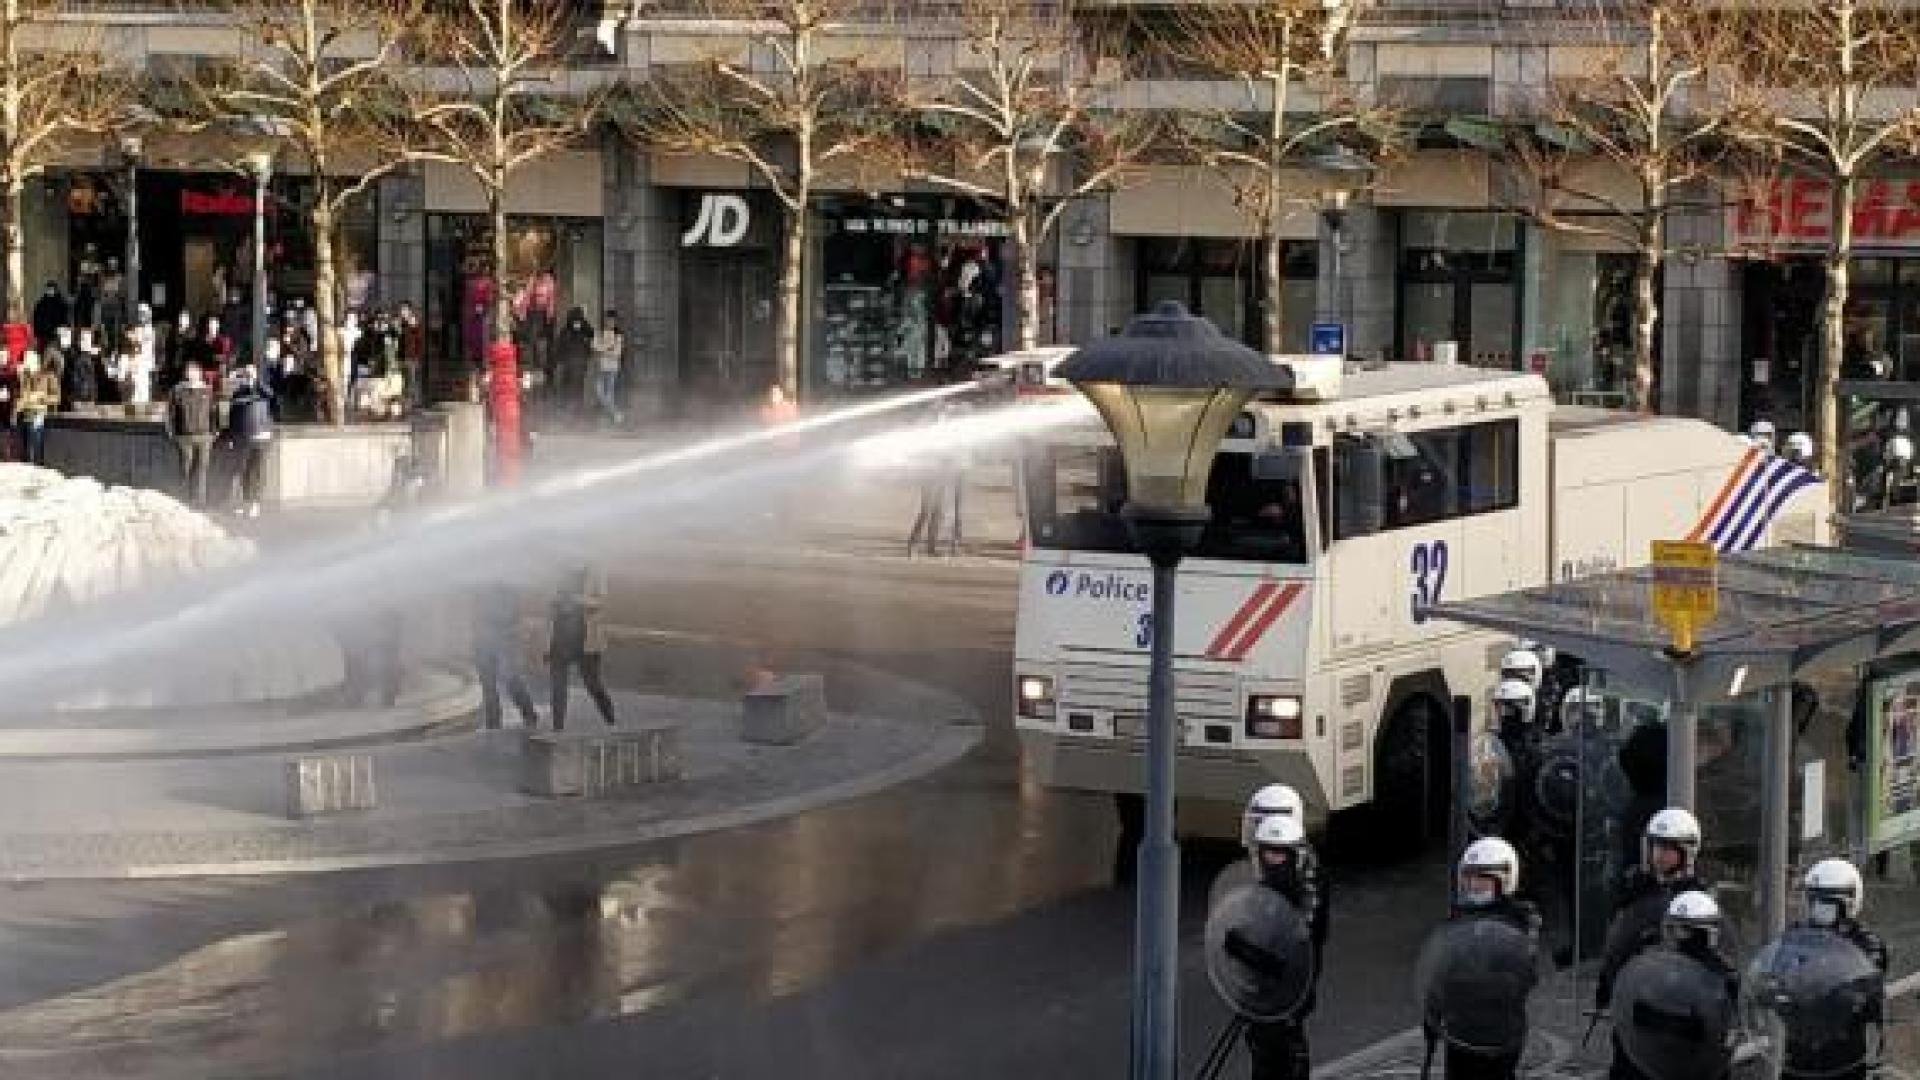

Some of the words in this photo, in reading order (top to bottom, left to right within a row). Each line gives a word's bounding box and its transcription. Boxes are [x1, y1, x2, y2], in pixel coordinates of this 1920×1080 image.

[682, 193, 750, 247] JD
[1075, 573, 1148, 601] Police
[1411, 540, 1448, 624] 32
[1136, 612, 1154, 648] 3
